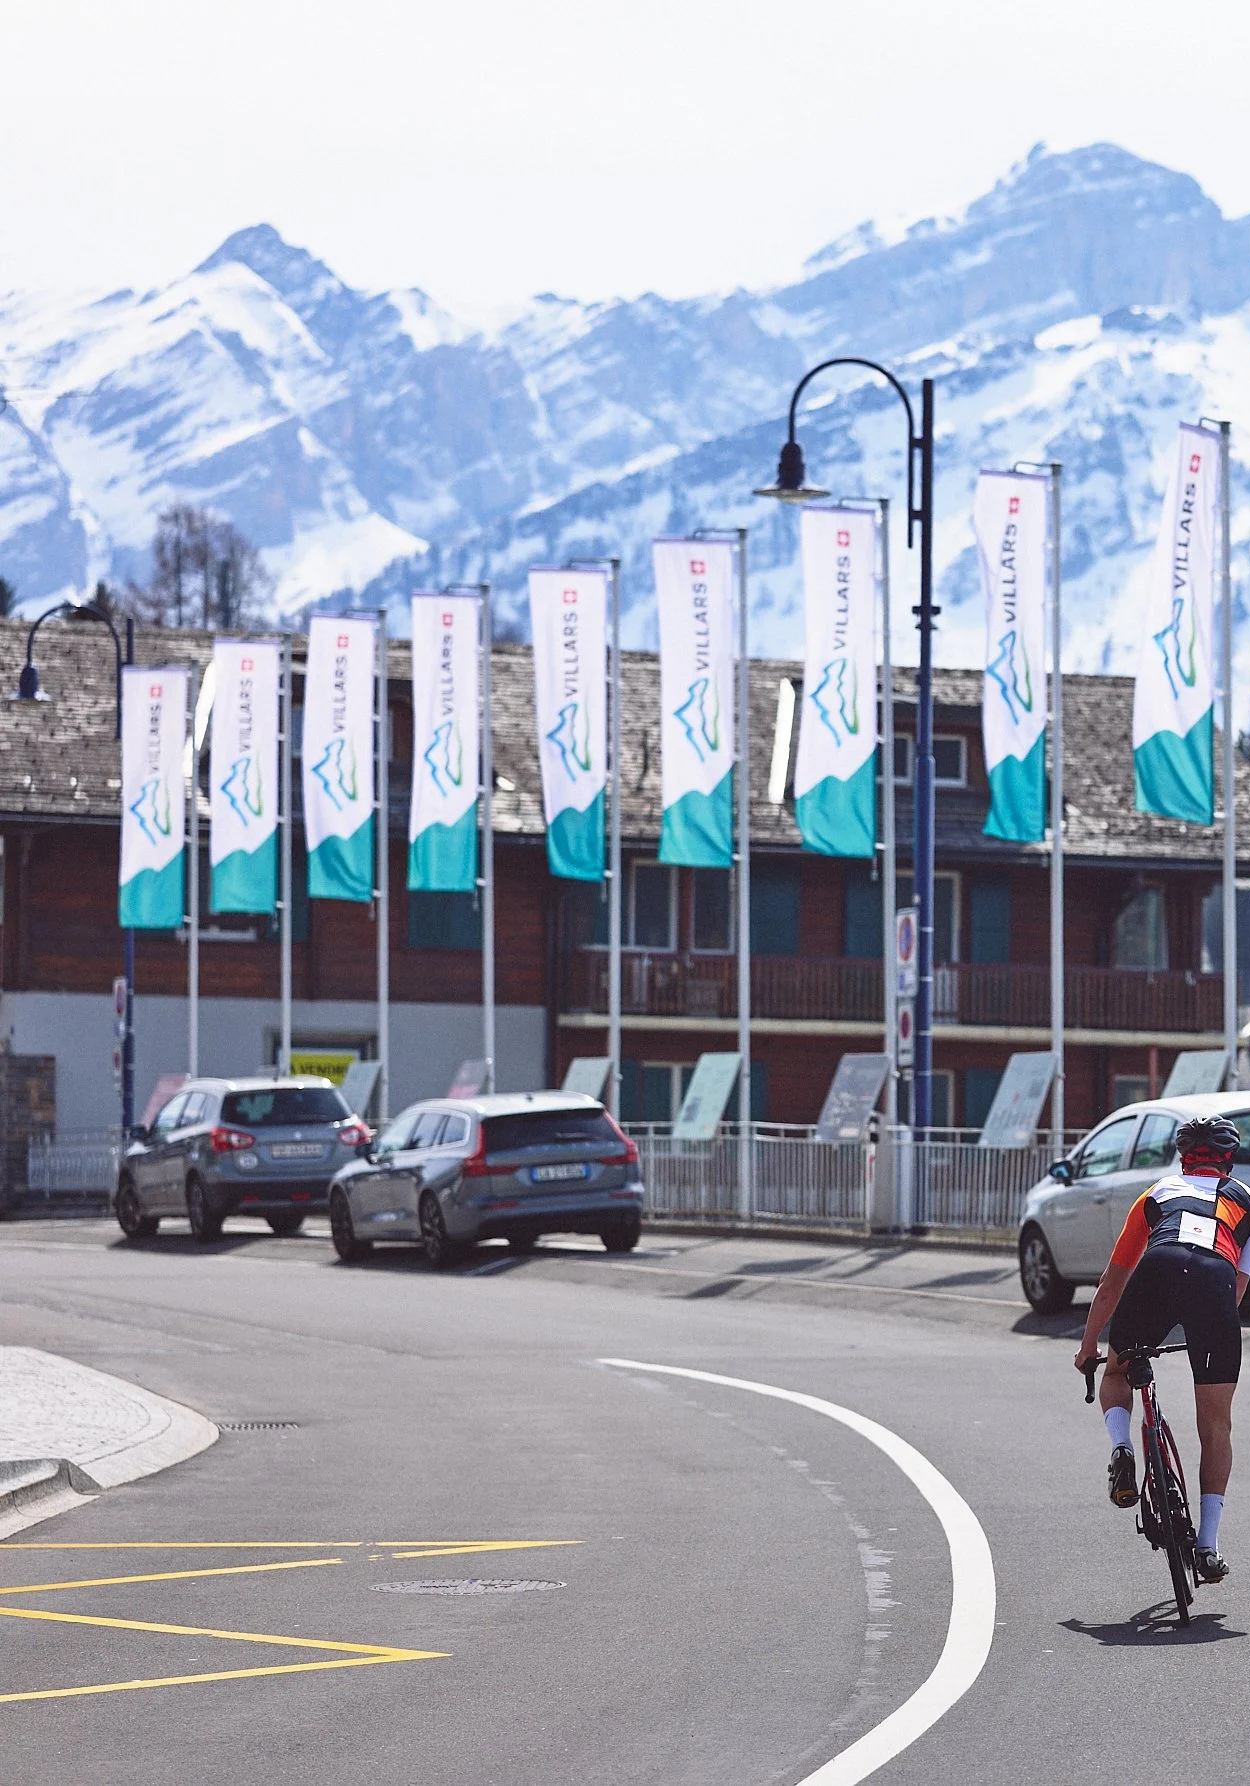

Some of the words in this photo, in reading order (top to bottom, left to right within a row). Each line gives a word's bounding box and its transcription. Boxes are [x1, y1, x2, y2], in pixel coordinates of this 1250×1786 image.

[1004, 523, 1018, 624] VILLARS
[1174, 482, 1197, 590] VILLARS
[695, 583, 709, 671] VILLARS
[833, 556, 851, 650] VILLARS
[333, 655, 348, 733] VILLARS
[443, 633, 456, 715] VILLARS
[564, 611, 578, 697] VILLARS
[150, 704, 162, 773] VILLARS
[239, 679, 253, 753] VILLARS
